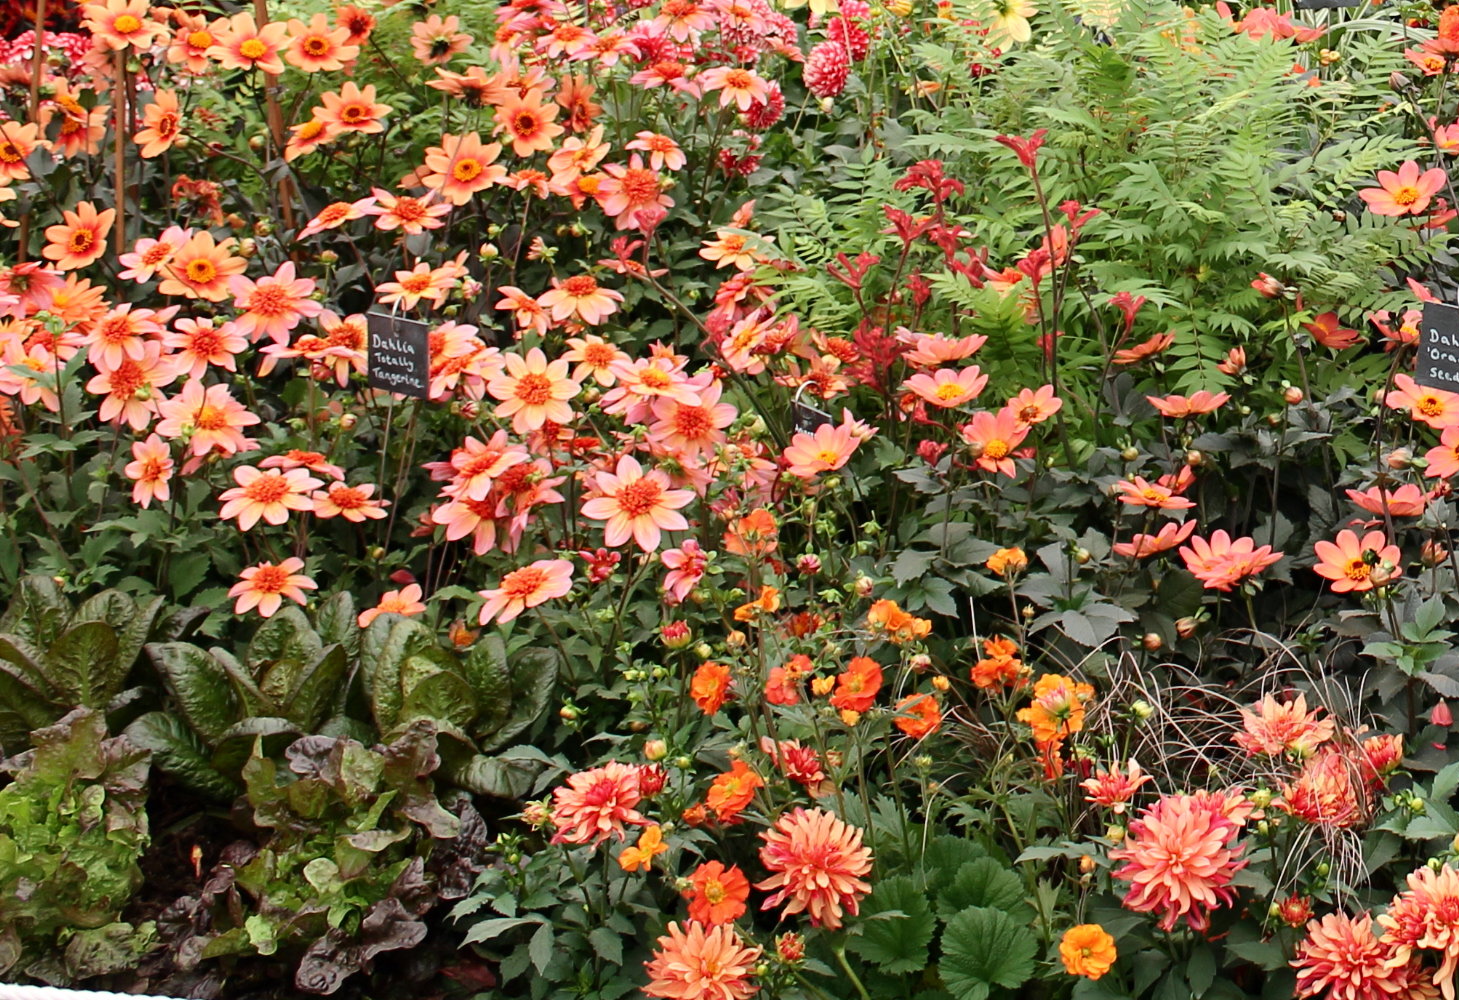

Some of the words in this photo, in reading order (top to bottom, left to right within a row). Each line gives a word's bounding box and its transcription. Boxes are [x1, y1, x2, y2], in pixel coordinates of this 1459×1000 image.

[372, 333, 415, 355] Dahlia
[374, 351, 414, 373] Totally
[371, 366, 425, 388] Tangerine
